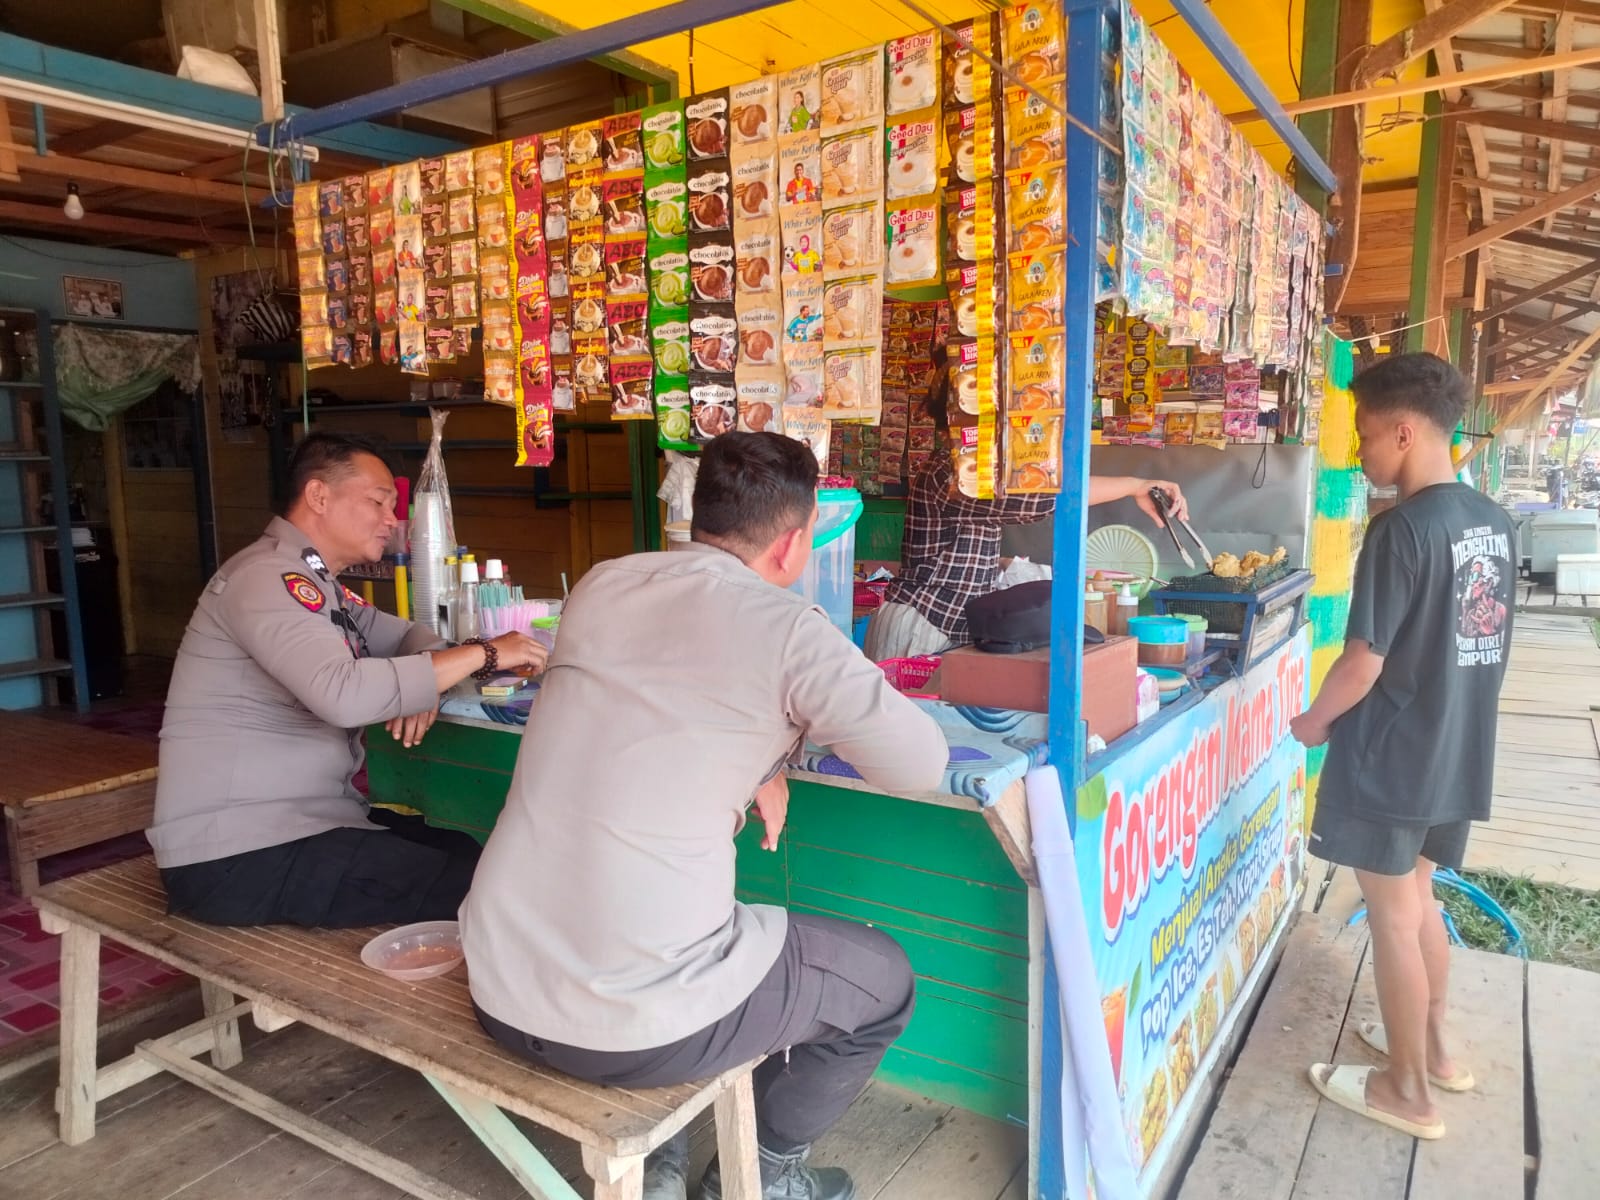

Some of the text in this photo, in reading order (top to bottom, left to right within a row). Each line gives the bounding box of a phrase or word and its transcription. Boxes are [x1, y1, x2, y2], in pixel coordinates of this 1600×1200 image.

[1020, 18, 1044, 32] TOP
[888, 34, 932, 55] Good Day
[1023, 103, 1047, 118] TOP
[608, 115, 640, 133] ABC
[889, 124, 933, 141] Good Day
[607, 179, 641, 195] ABC
[1023, 189, 1047, 201] TOP
[890, 210, 934, 226] Good Day
[610, 242, 644, 258] ABC
[1024, 272, 1046, 284] TOP
[611, 304, 645, 319] ABC
[1025, 353, 1046, 365] TOP
[614, 365, 650, 379] ABC
[1023, 433, 1045, 445] TOP
[1102, 640, 1305, 930] Gorengan Mama Tina
[1151, 786, 1281, 974] Menjual Aneka Gorengan
[1171, 951, 1197, 1003] Ice,
[1198, 922, 1213, 965] Es
[1214, 889, 1237, 938] Teh,
